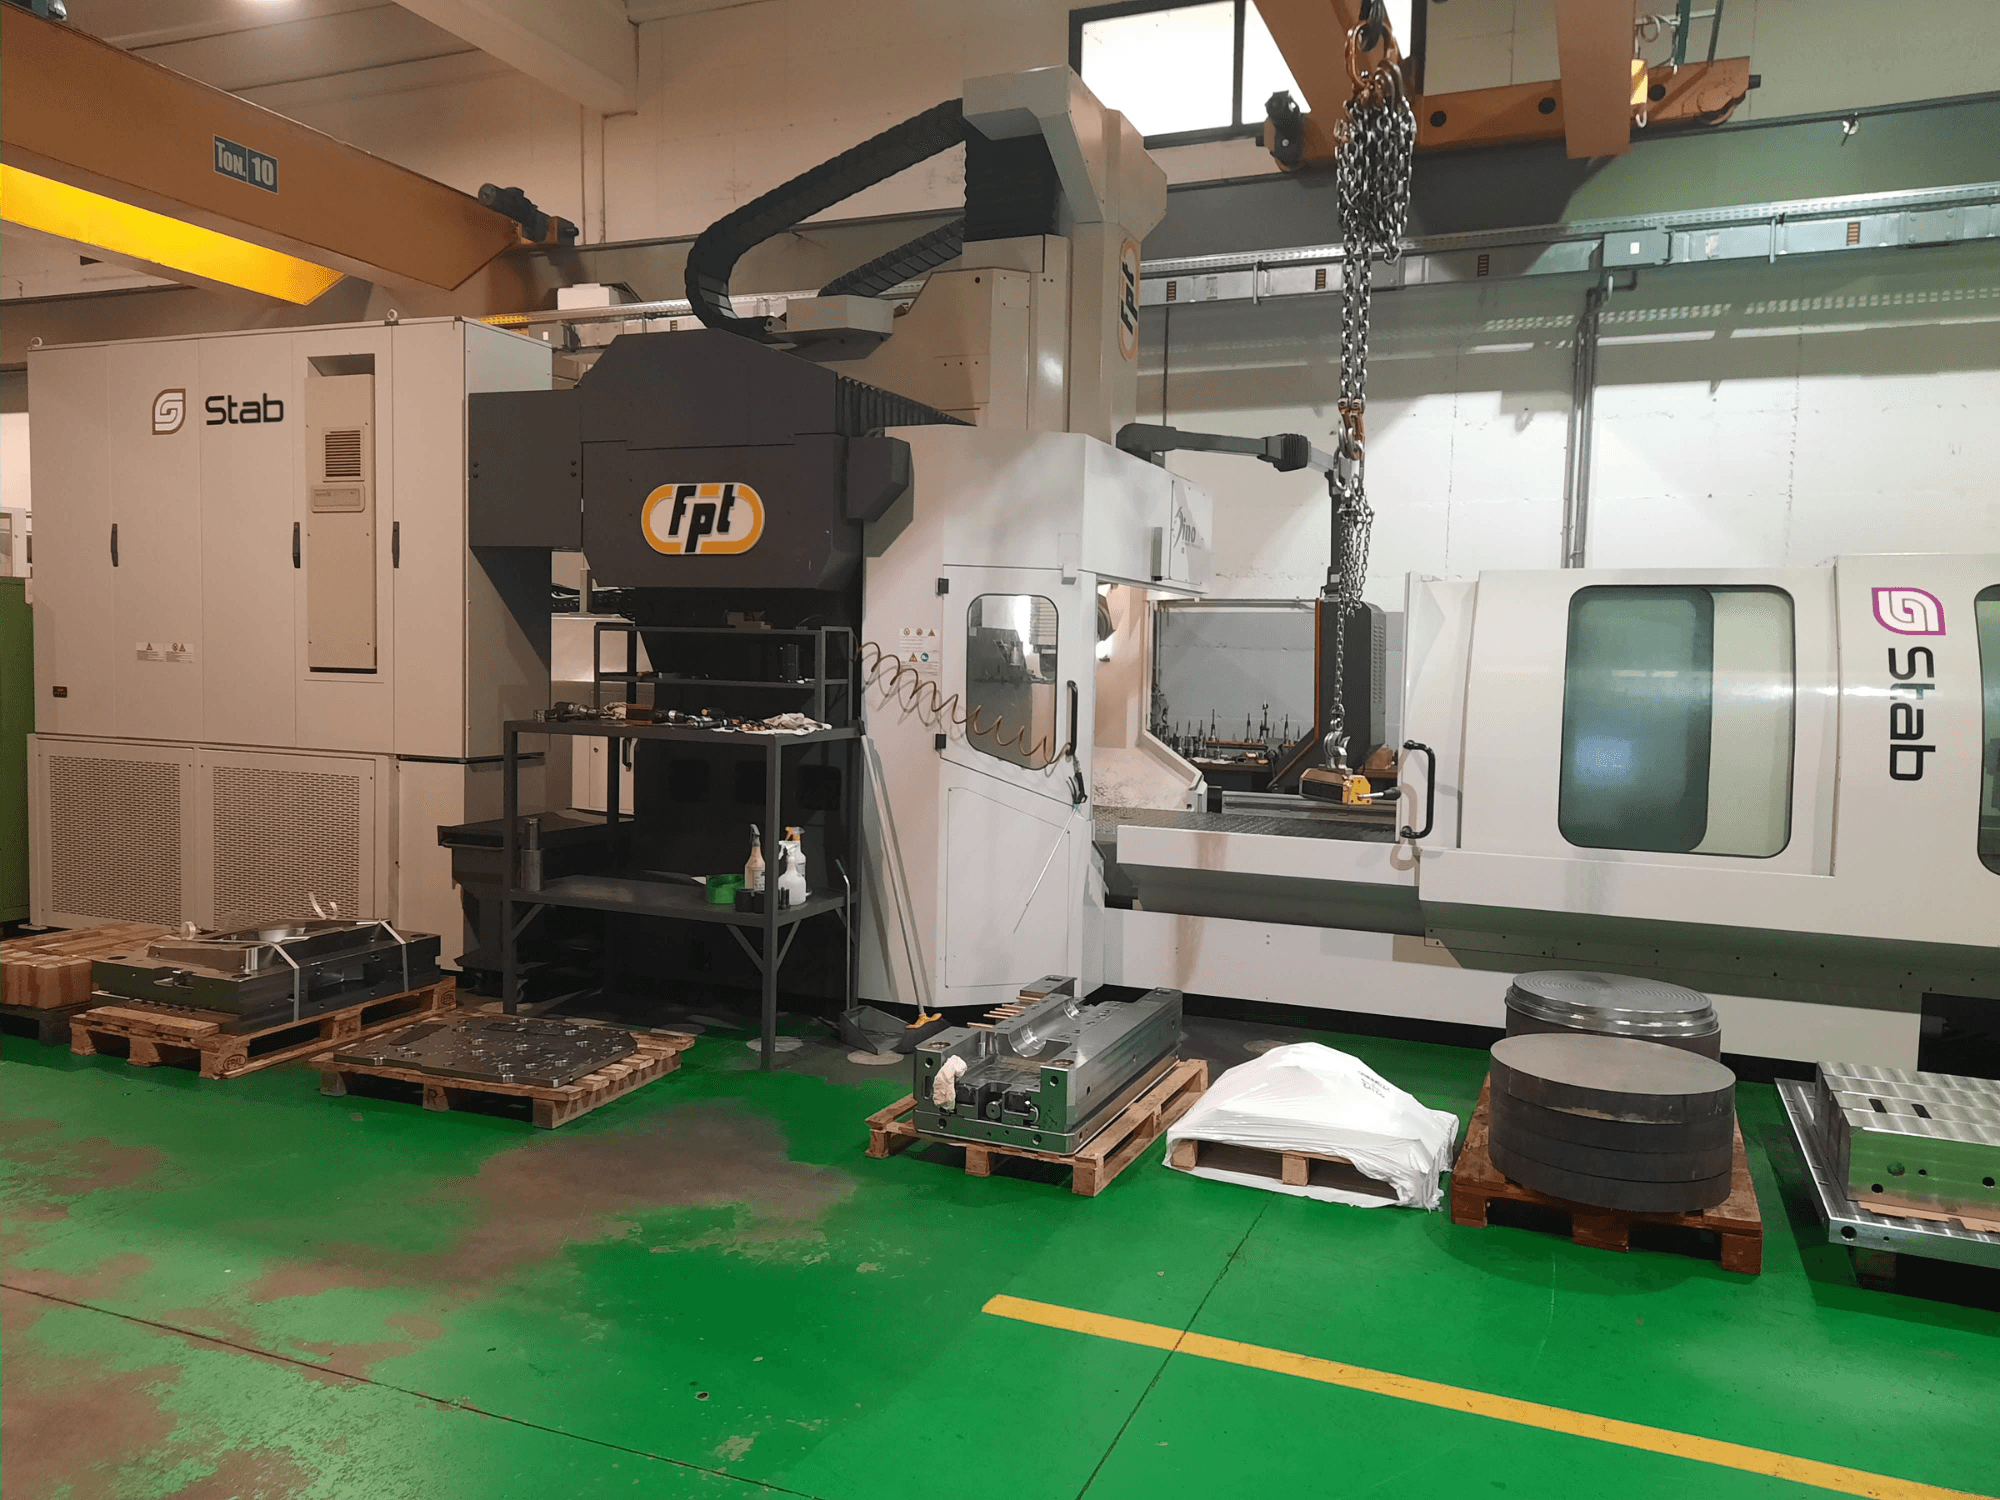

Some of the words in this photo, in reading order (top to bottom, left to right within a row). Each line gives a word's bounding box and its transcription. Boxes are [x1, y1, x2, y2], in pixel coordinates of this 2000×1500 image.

[251, 156, 274, 186] 10
[205, 392, 284, 426] Stab
[1887, 646, 1937, 781] Stab
